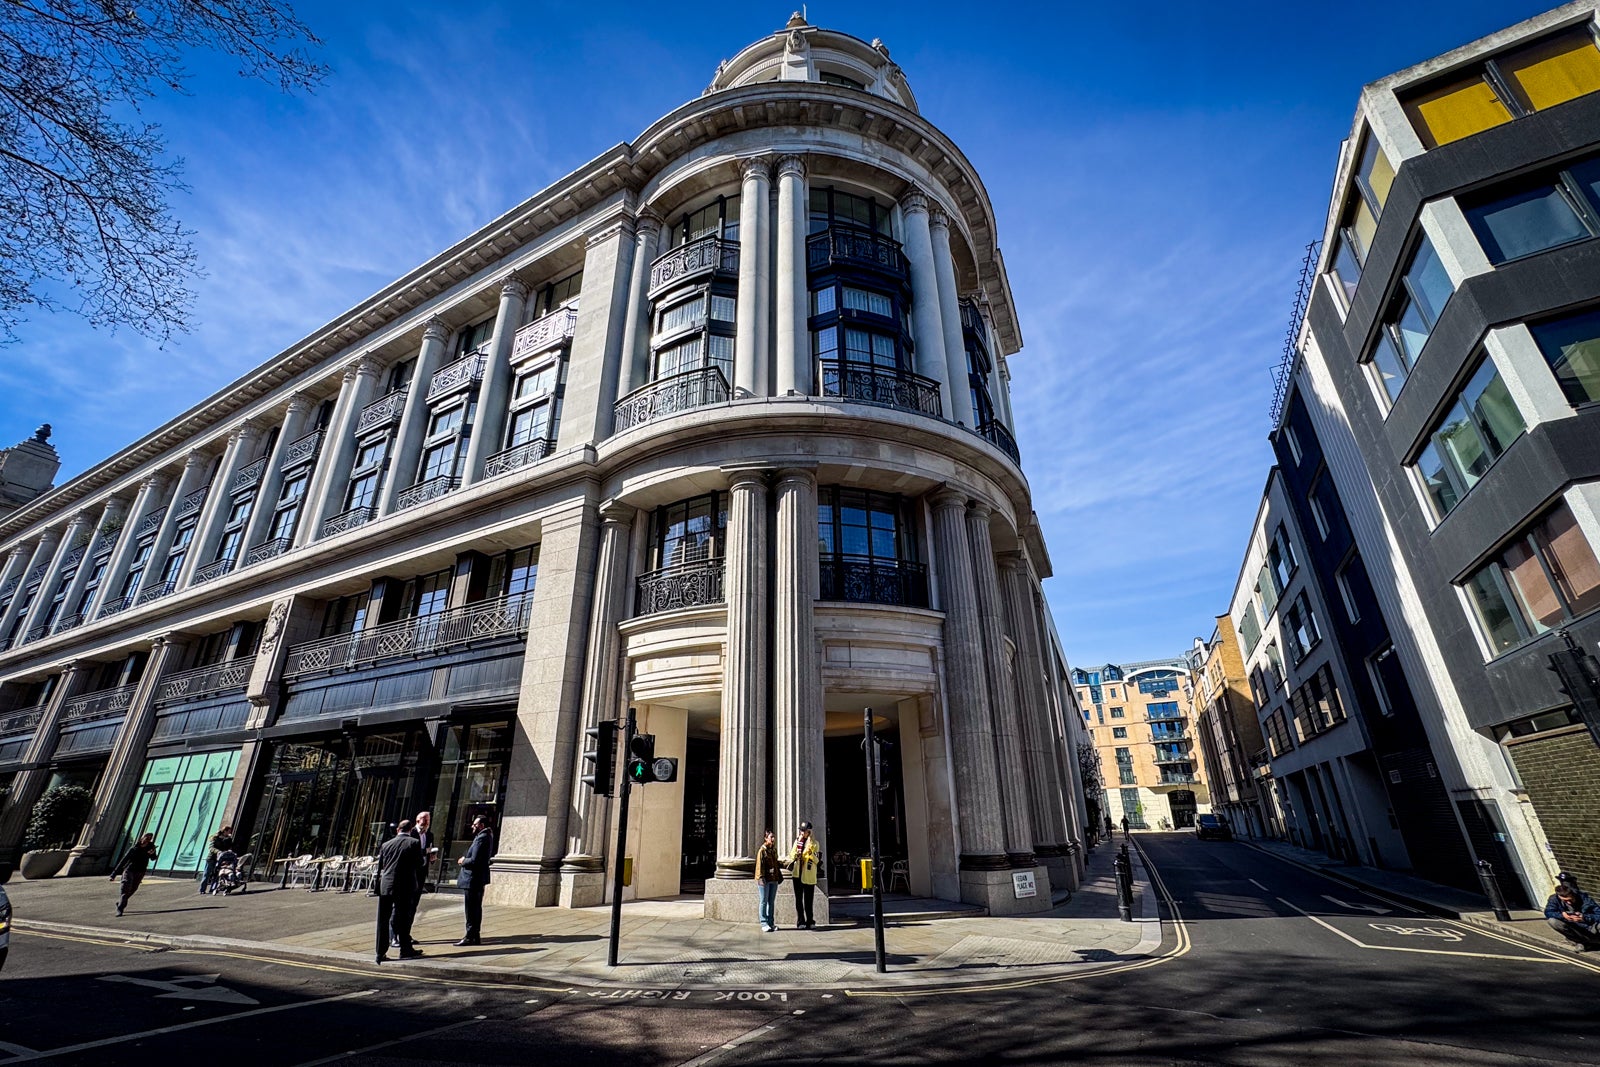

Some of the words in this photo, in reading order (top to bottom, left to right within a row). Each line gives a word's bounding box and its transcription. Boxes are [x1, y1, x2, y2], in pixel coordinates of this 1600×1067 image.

[1017, 882, 1028, 890] PLACE
[600, 989, 691, 1001] RIGHT
[714, 991, 788, 1002] LOOK
